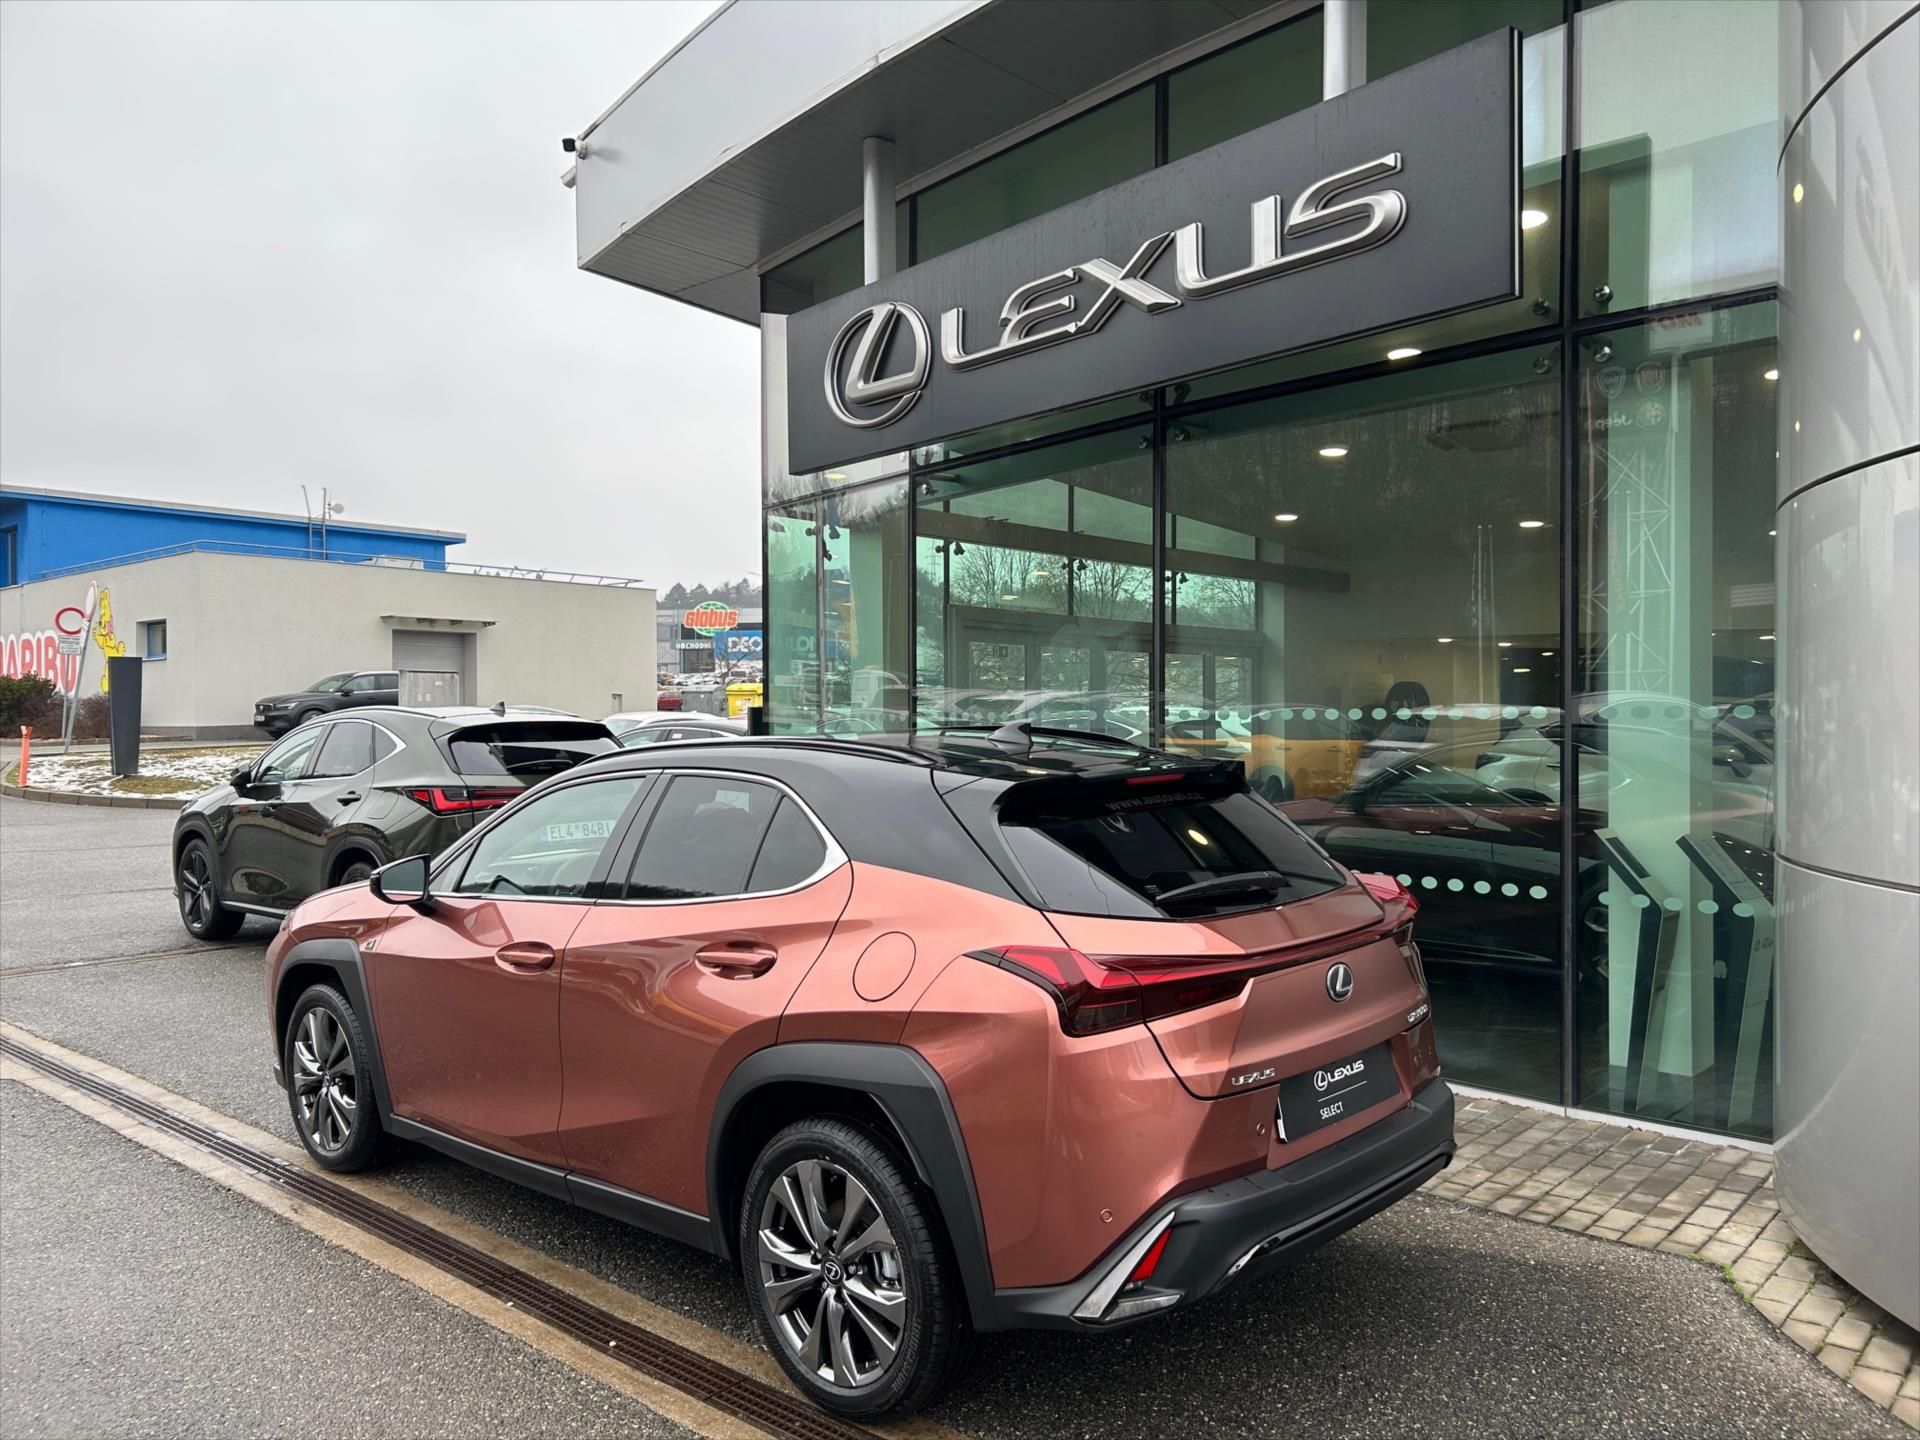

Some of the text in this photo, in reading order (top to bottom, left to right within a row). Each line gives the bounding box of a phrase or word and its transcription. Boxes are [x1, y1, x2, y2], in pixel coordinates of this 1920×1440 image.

[940, 151, 1408, 371] LEXUS
[1231, 1067, 1275, 1086] LEXUS
[1327, 1059, 1364, 1082] LEXUS
[1320, 1101, 1344, 1120] SELECT
